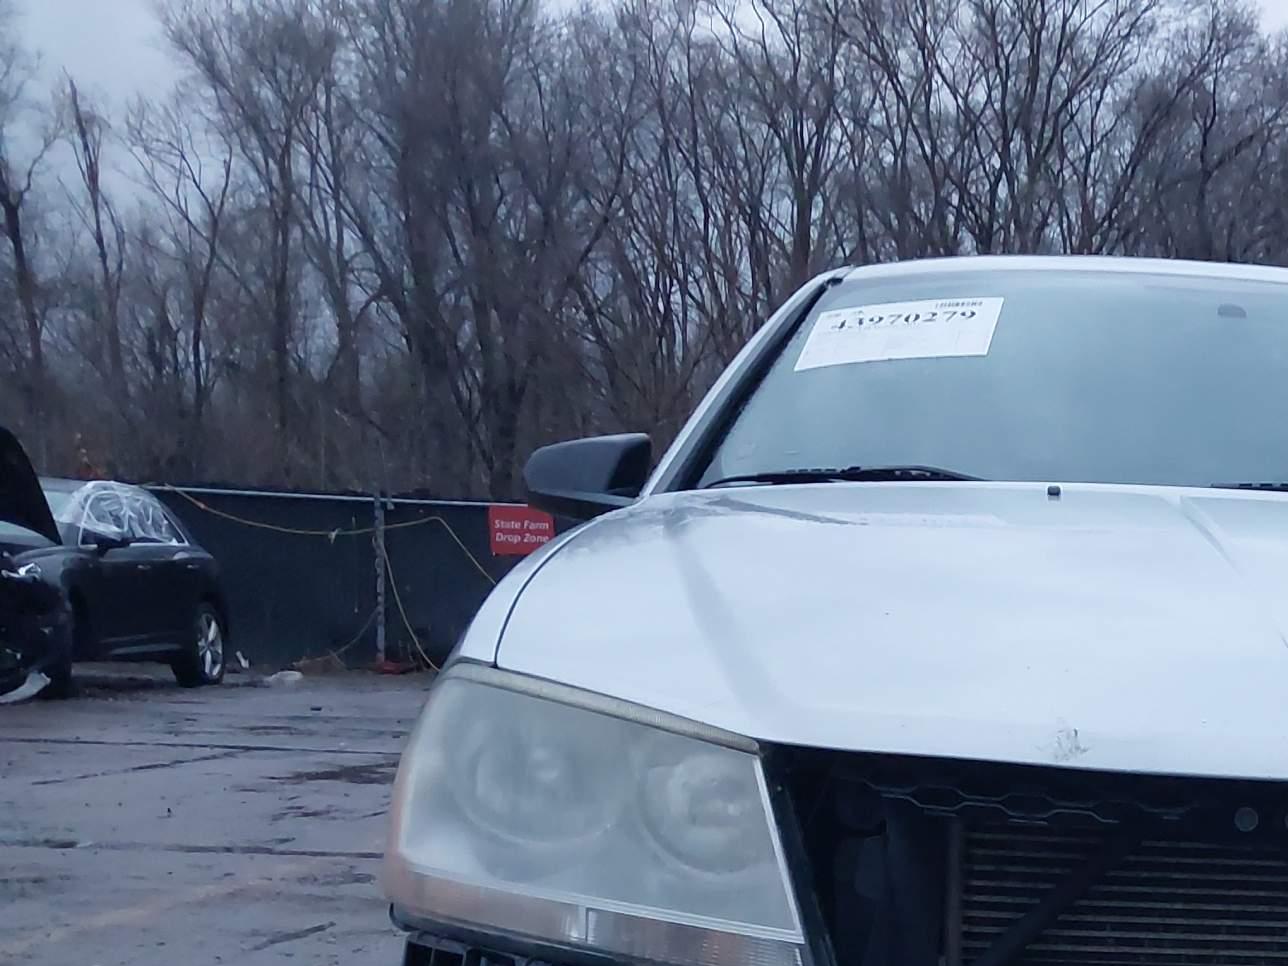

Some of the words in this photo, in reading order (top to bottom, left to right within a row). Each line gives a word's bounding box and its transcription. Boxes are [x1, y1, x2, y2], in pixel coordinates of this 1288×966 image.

[830, 309, 977, 331] 43970279
[494, 519, 521, 529] State
[523, 519, 549, 529] Farm
[495, 532, 521, 544] Drop
[523, 533, 549, 543] Zone
